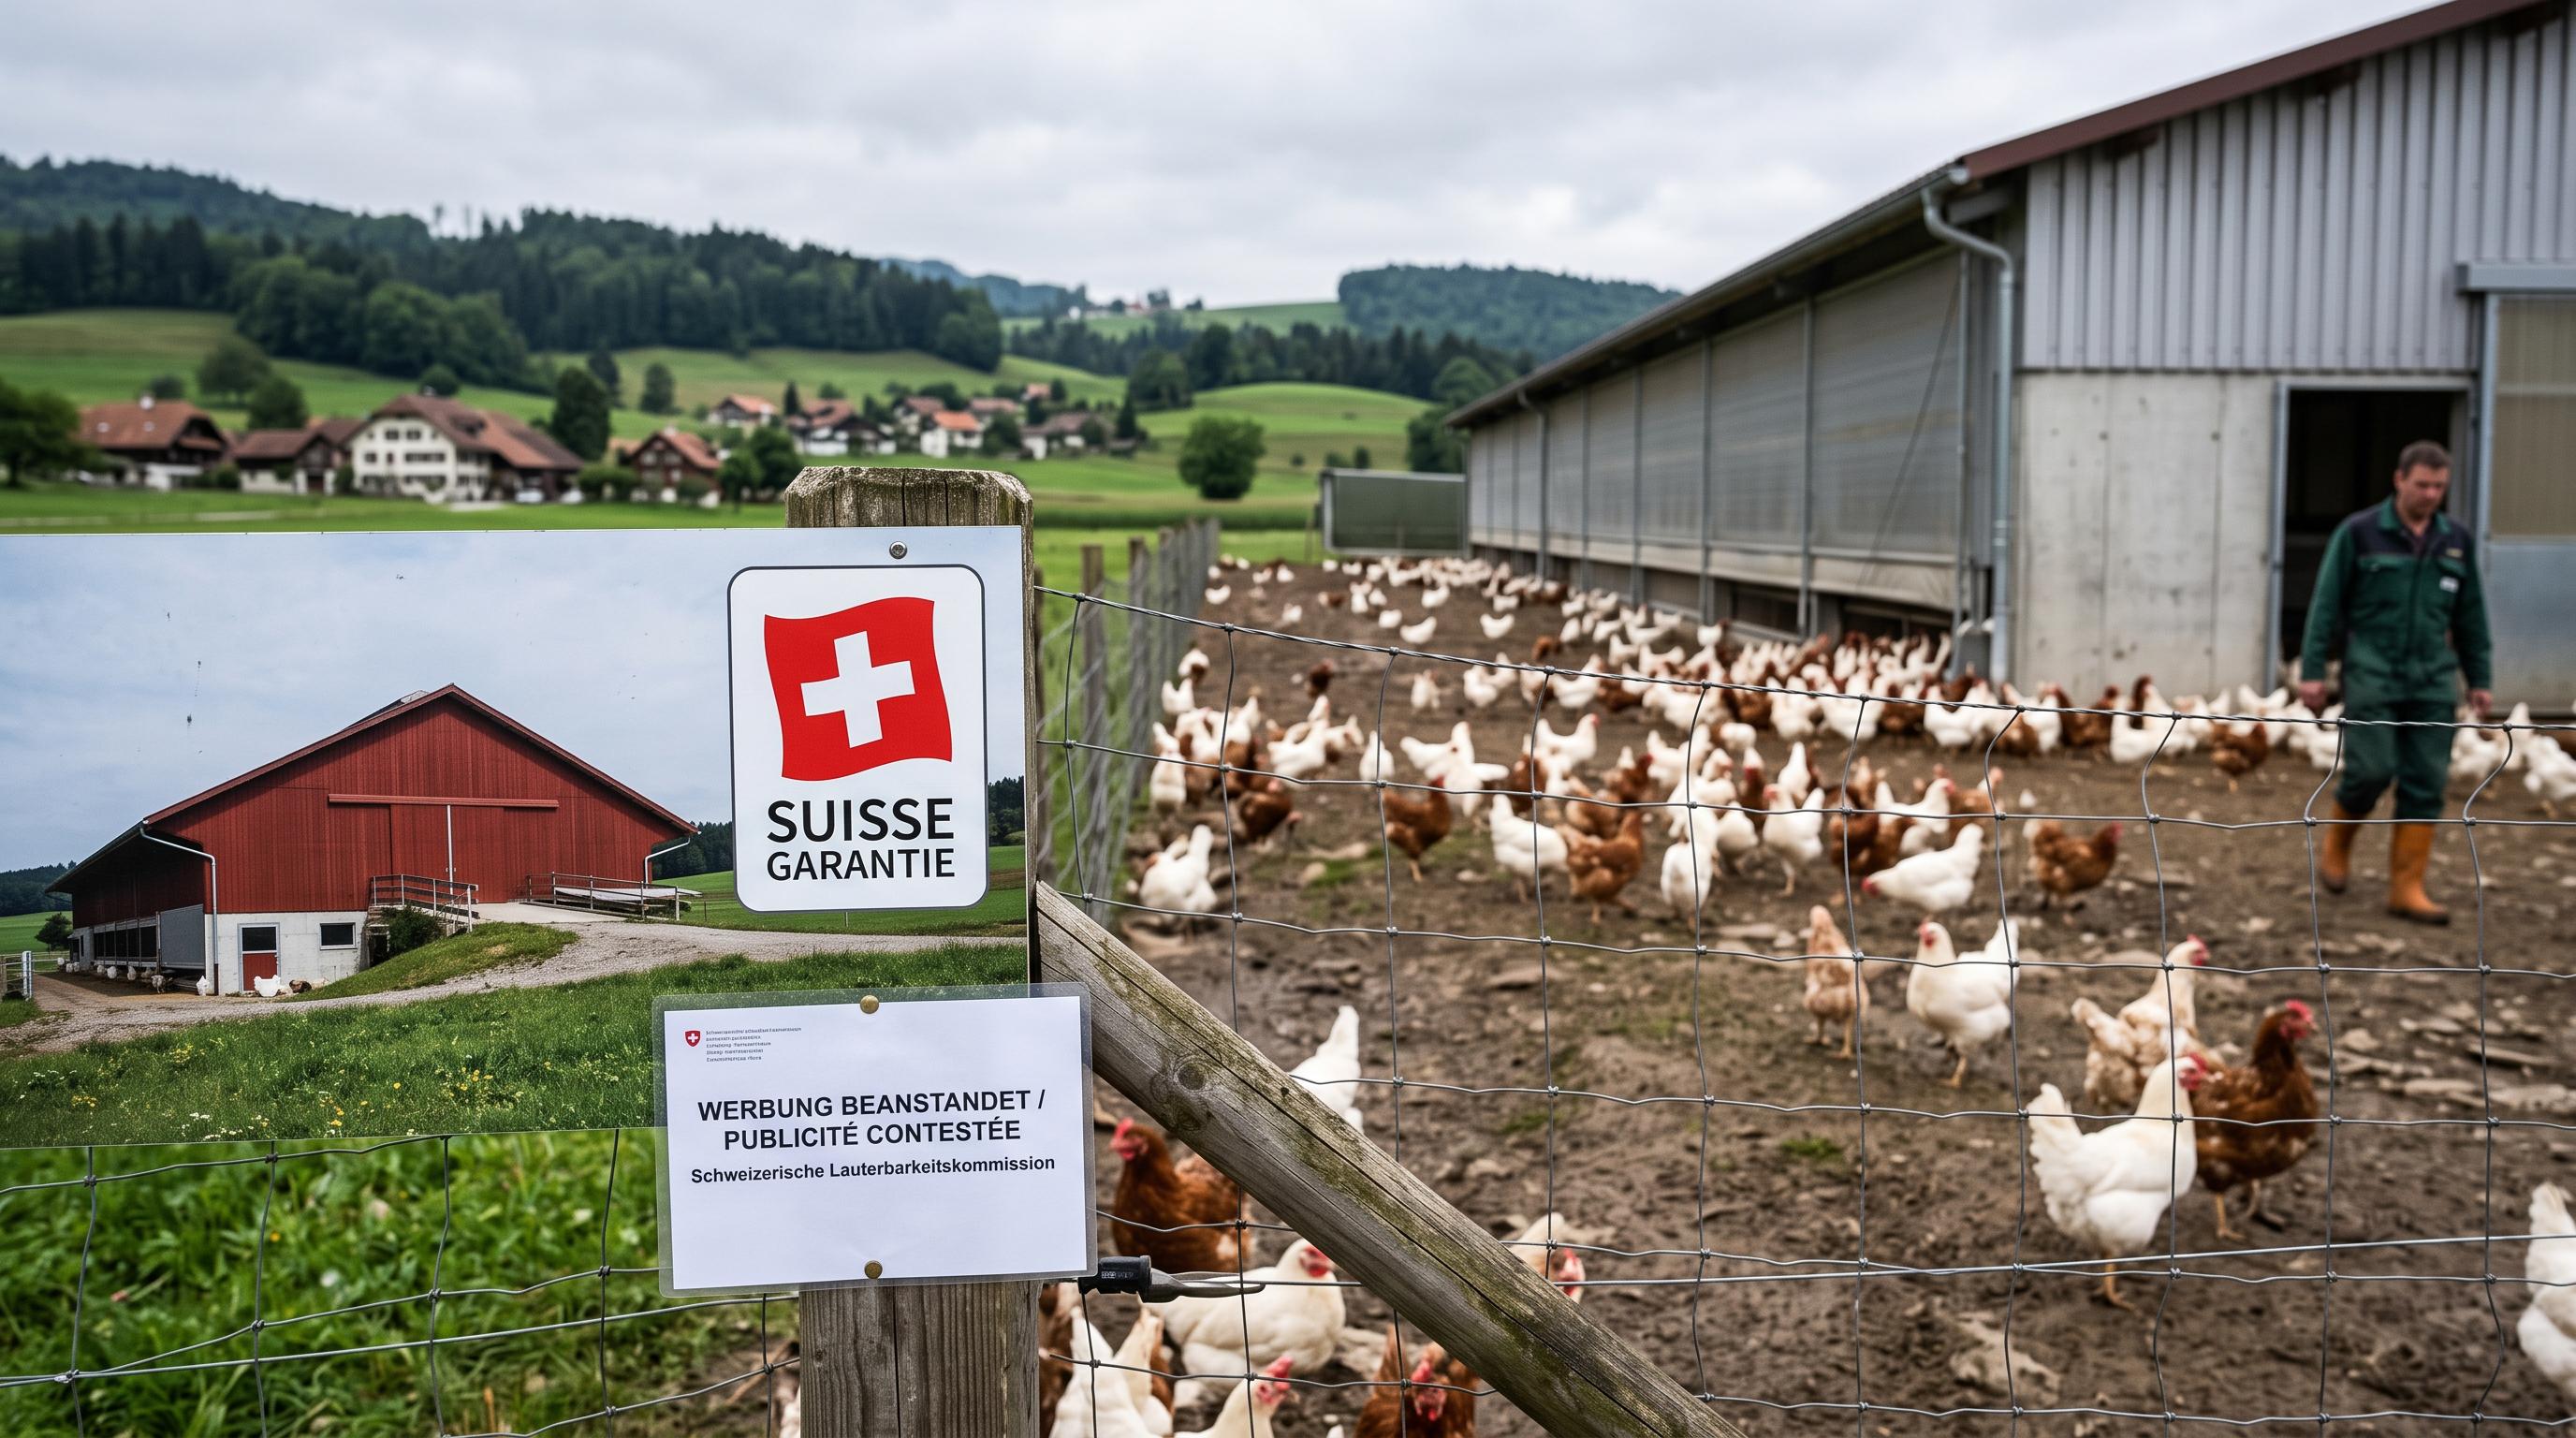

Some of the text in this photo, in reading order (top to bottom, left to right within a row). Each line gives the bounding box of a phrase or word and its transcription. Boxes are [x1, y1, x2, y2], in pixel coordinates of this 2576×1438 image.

[767, 798, 955, 844] SUISSE
[767, 847, 956, 882] GARANTIE
[697, 1089, 1046, 1122] WERBUNG BEANSTANDET /
[724, 1115, 1021, 1151] PUBLICITÉ CONTESTÉE
[691, 1155, 1056, 1184] Schweizerische Lauterbarkeitskommission
